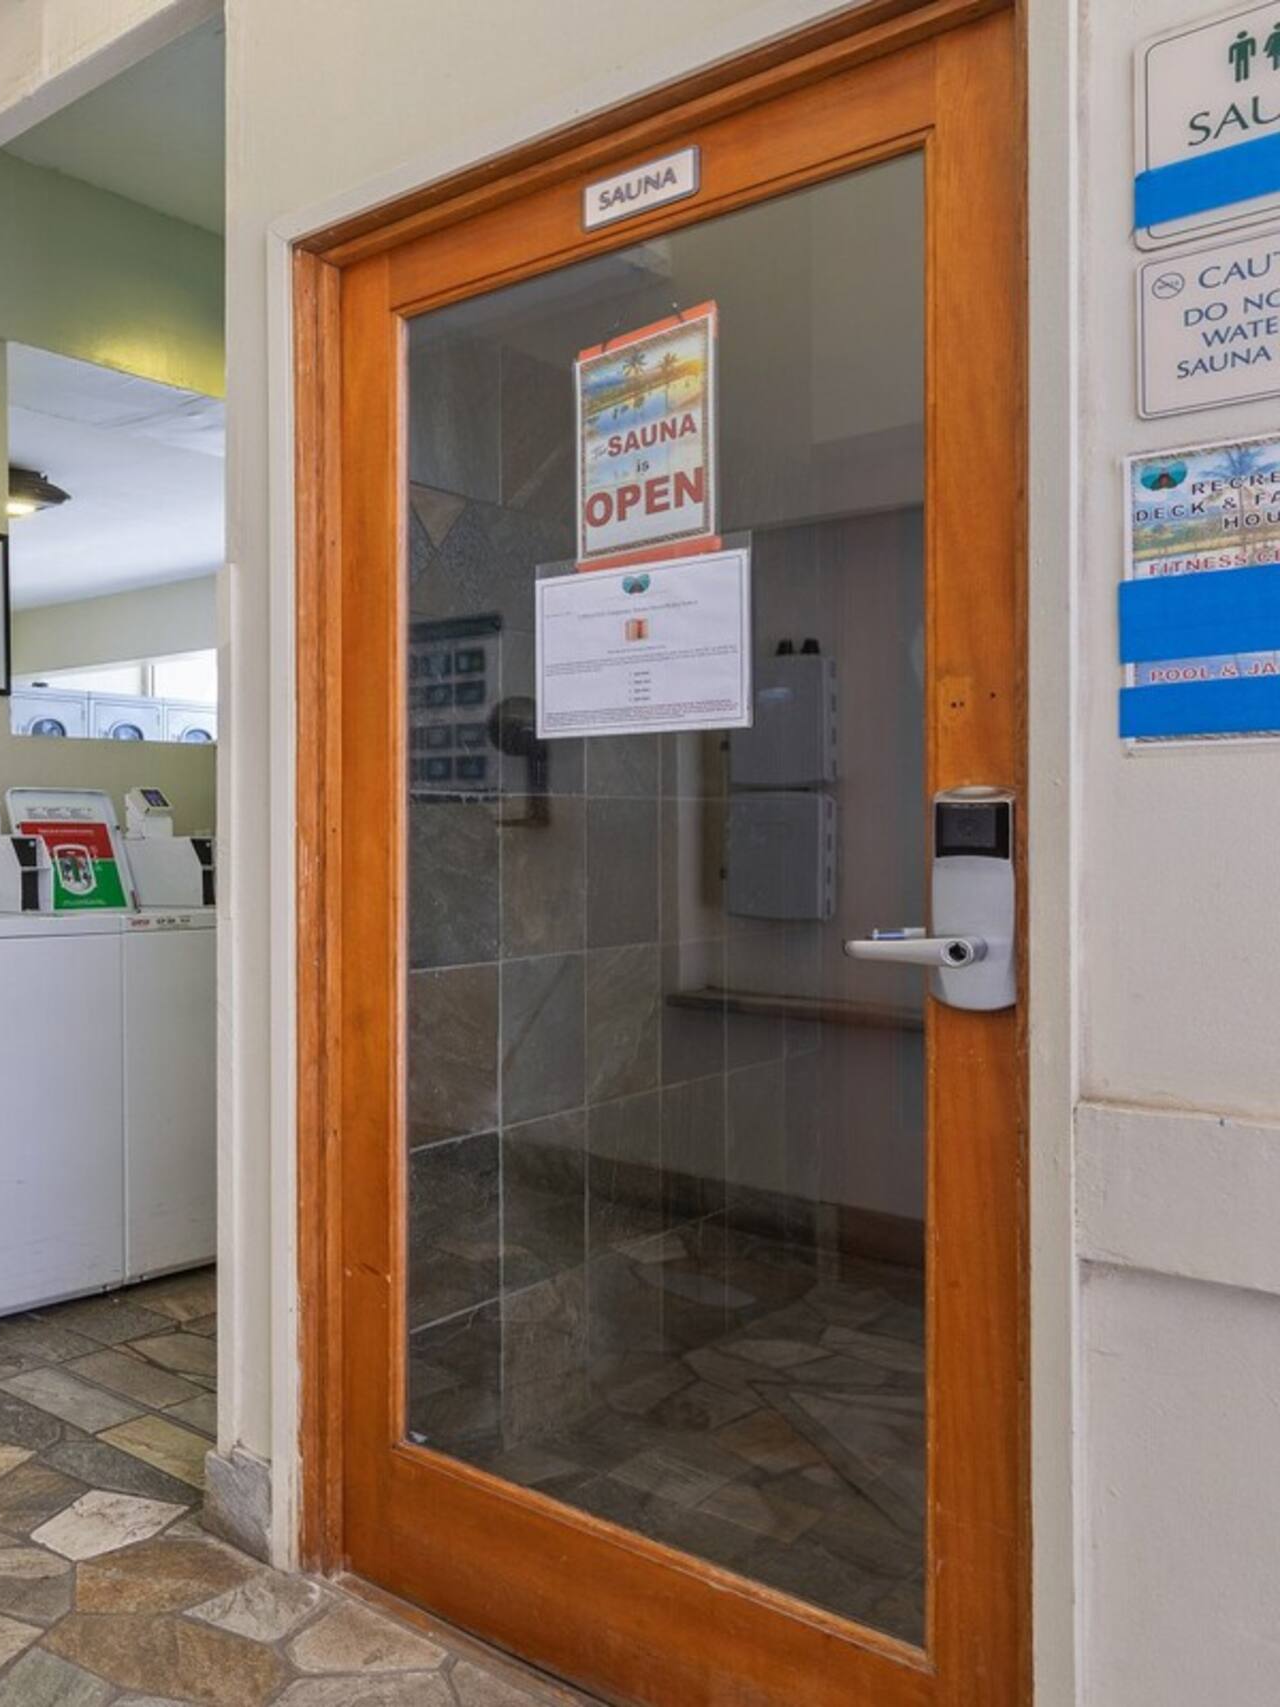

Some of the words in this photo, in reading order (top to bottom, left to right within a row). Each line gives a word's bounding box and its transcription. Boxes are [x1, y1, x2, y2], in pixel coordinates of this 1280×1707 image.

[598, 166, 677, 211] SAUNA
[1183, 302, 1228, 328] DO
[1202, 315, 1279, 348] WATE
[1177, 345, 1272, 379] SAUNA
[607, 413, 697, 457] SAUNA
[636, 460, 650, 473] is
[586, 466, 704, 528] OPEN
[1136, 501, 1205, 522] DECK
[1222, 496, 1237, 509] &
[1149, 553, 1248, 576] FITNESS
[1151, 667, 1209, 681] POOL
